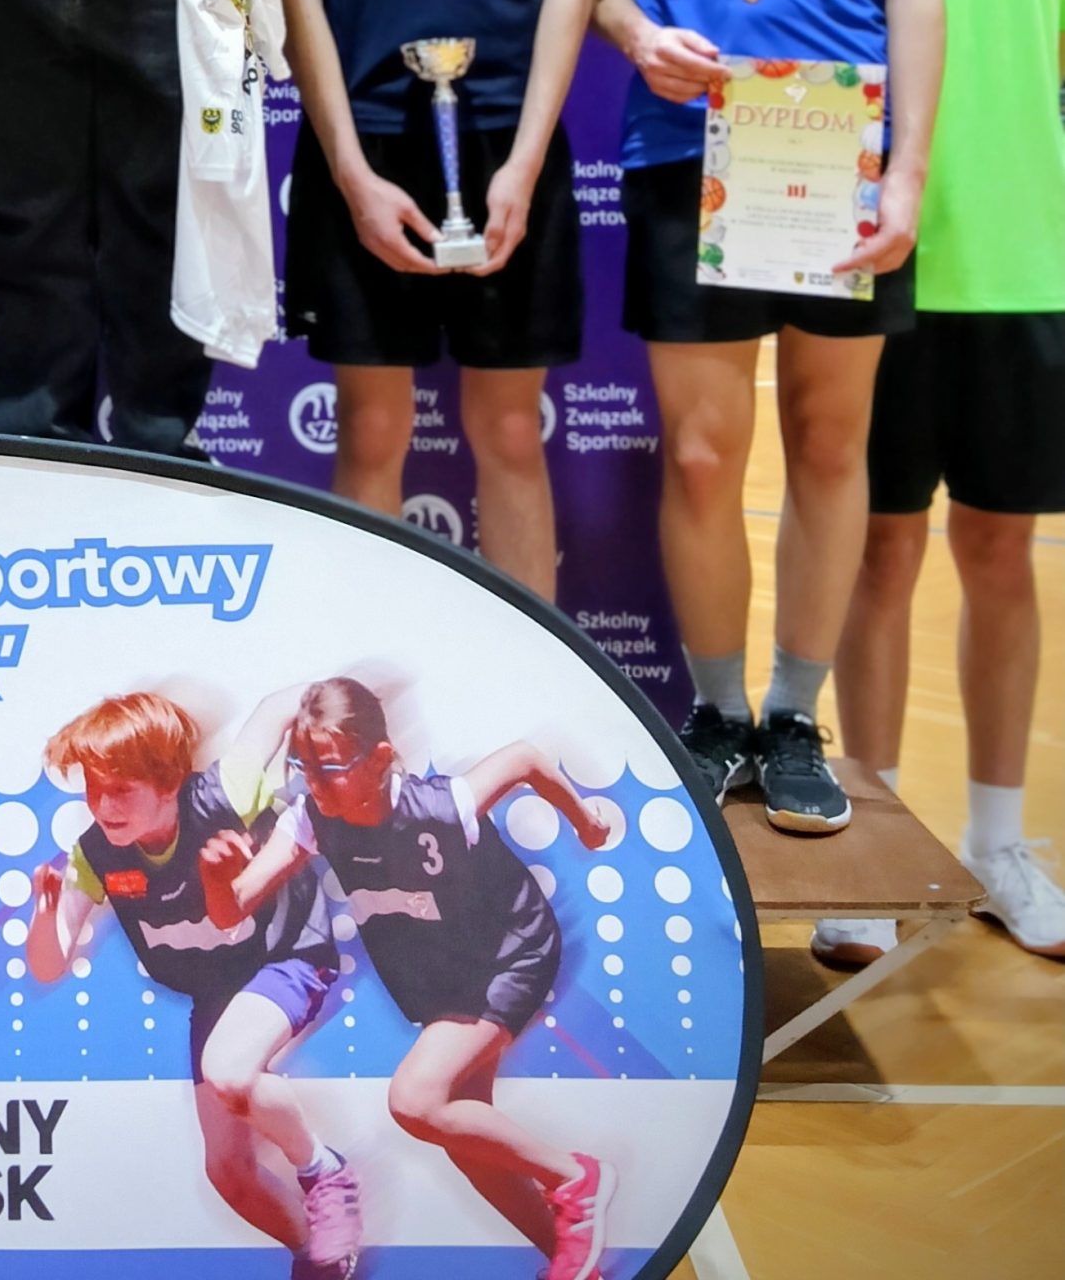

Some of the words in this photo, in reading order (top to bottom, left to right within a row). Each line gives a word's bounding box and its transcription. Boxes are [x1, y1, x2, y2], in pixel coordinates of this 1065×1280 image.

[733, 104, 857, 134] DYPLOM
[573, 160, 625, 181] kolny
[205, 387, 244, 409] olny
[564, 383, 638, 405] Szkolny
[565, 408, 645, 430] Związek
[200, 435, 264, 456] ortowy
[566, 431, 659, 454] Sportowy
[575, 610, 650, 633] Szkolny
[418, 832, 443, 875] 3
